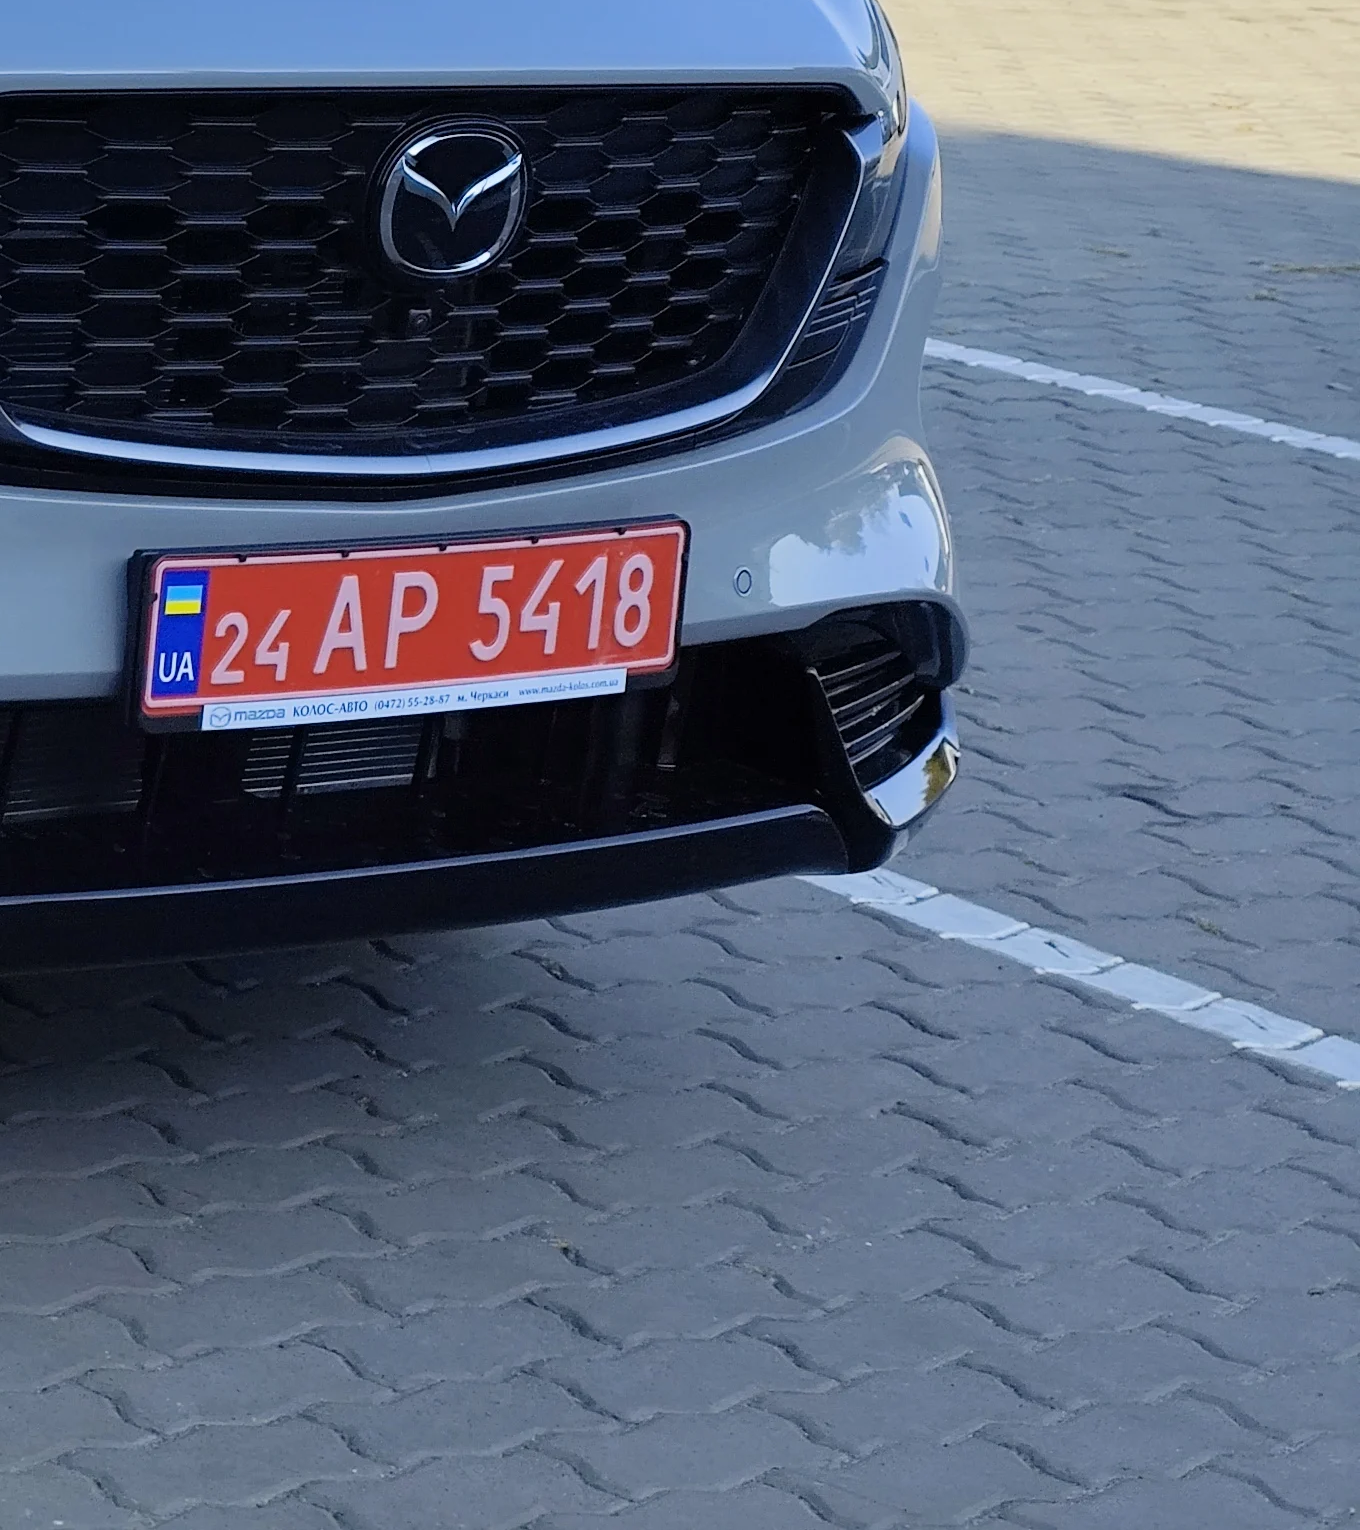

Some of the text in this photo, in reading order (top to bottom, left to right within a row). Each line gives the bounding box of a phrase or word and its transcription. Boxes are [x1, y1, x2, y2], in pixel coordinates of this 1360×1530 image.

[210, 553, 654, 686] 24 AP 5418
[158, 651, 195, 683] UA
[234, 708, 285, 722] mazda
[292, 700, 368, 719] КОЛОС-АВТО
[374, 697, 405, 712] (0472)
[407, 693, 451, 708] 55-28-87
[470, 689, 510, 703] Черкаси
